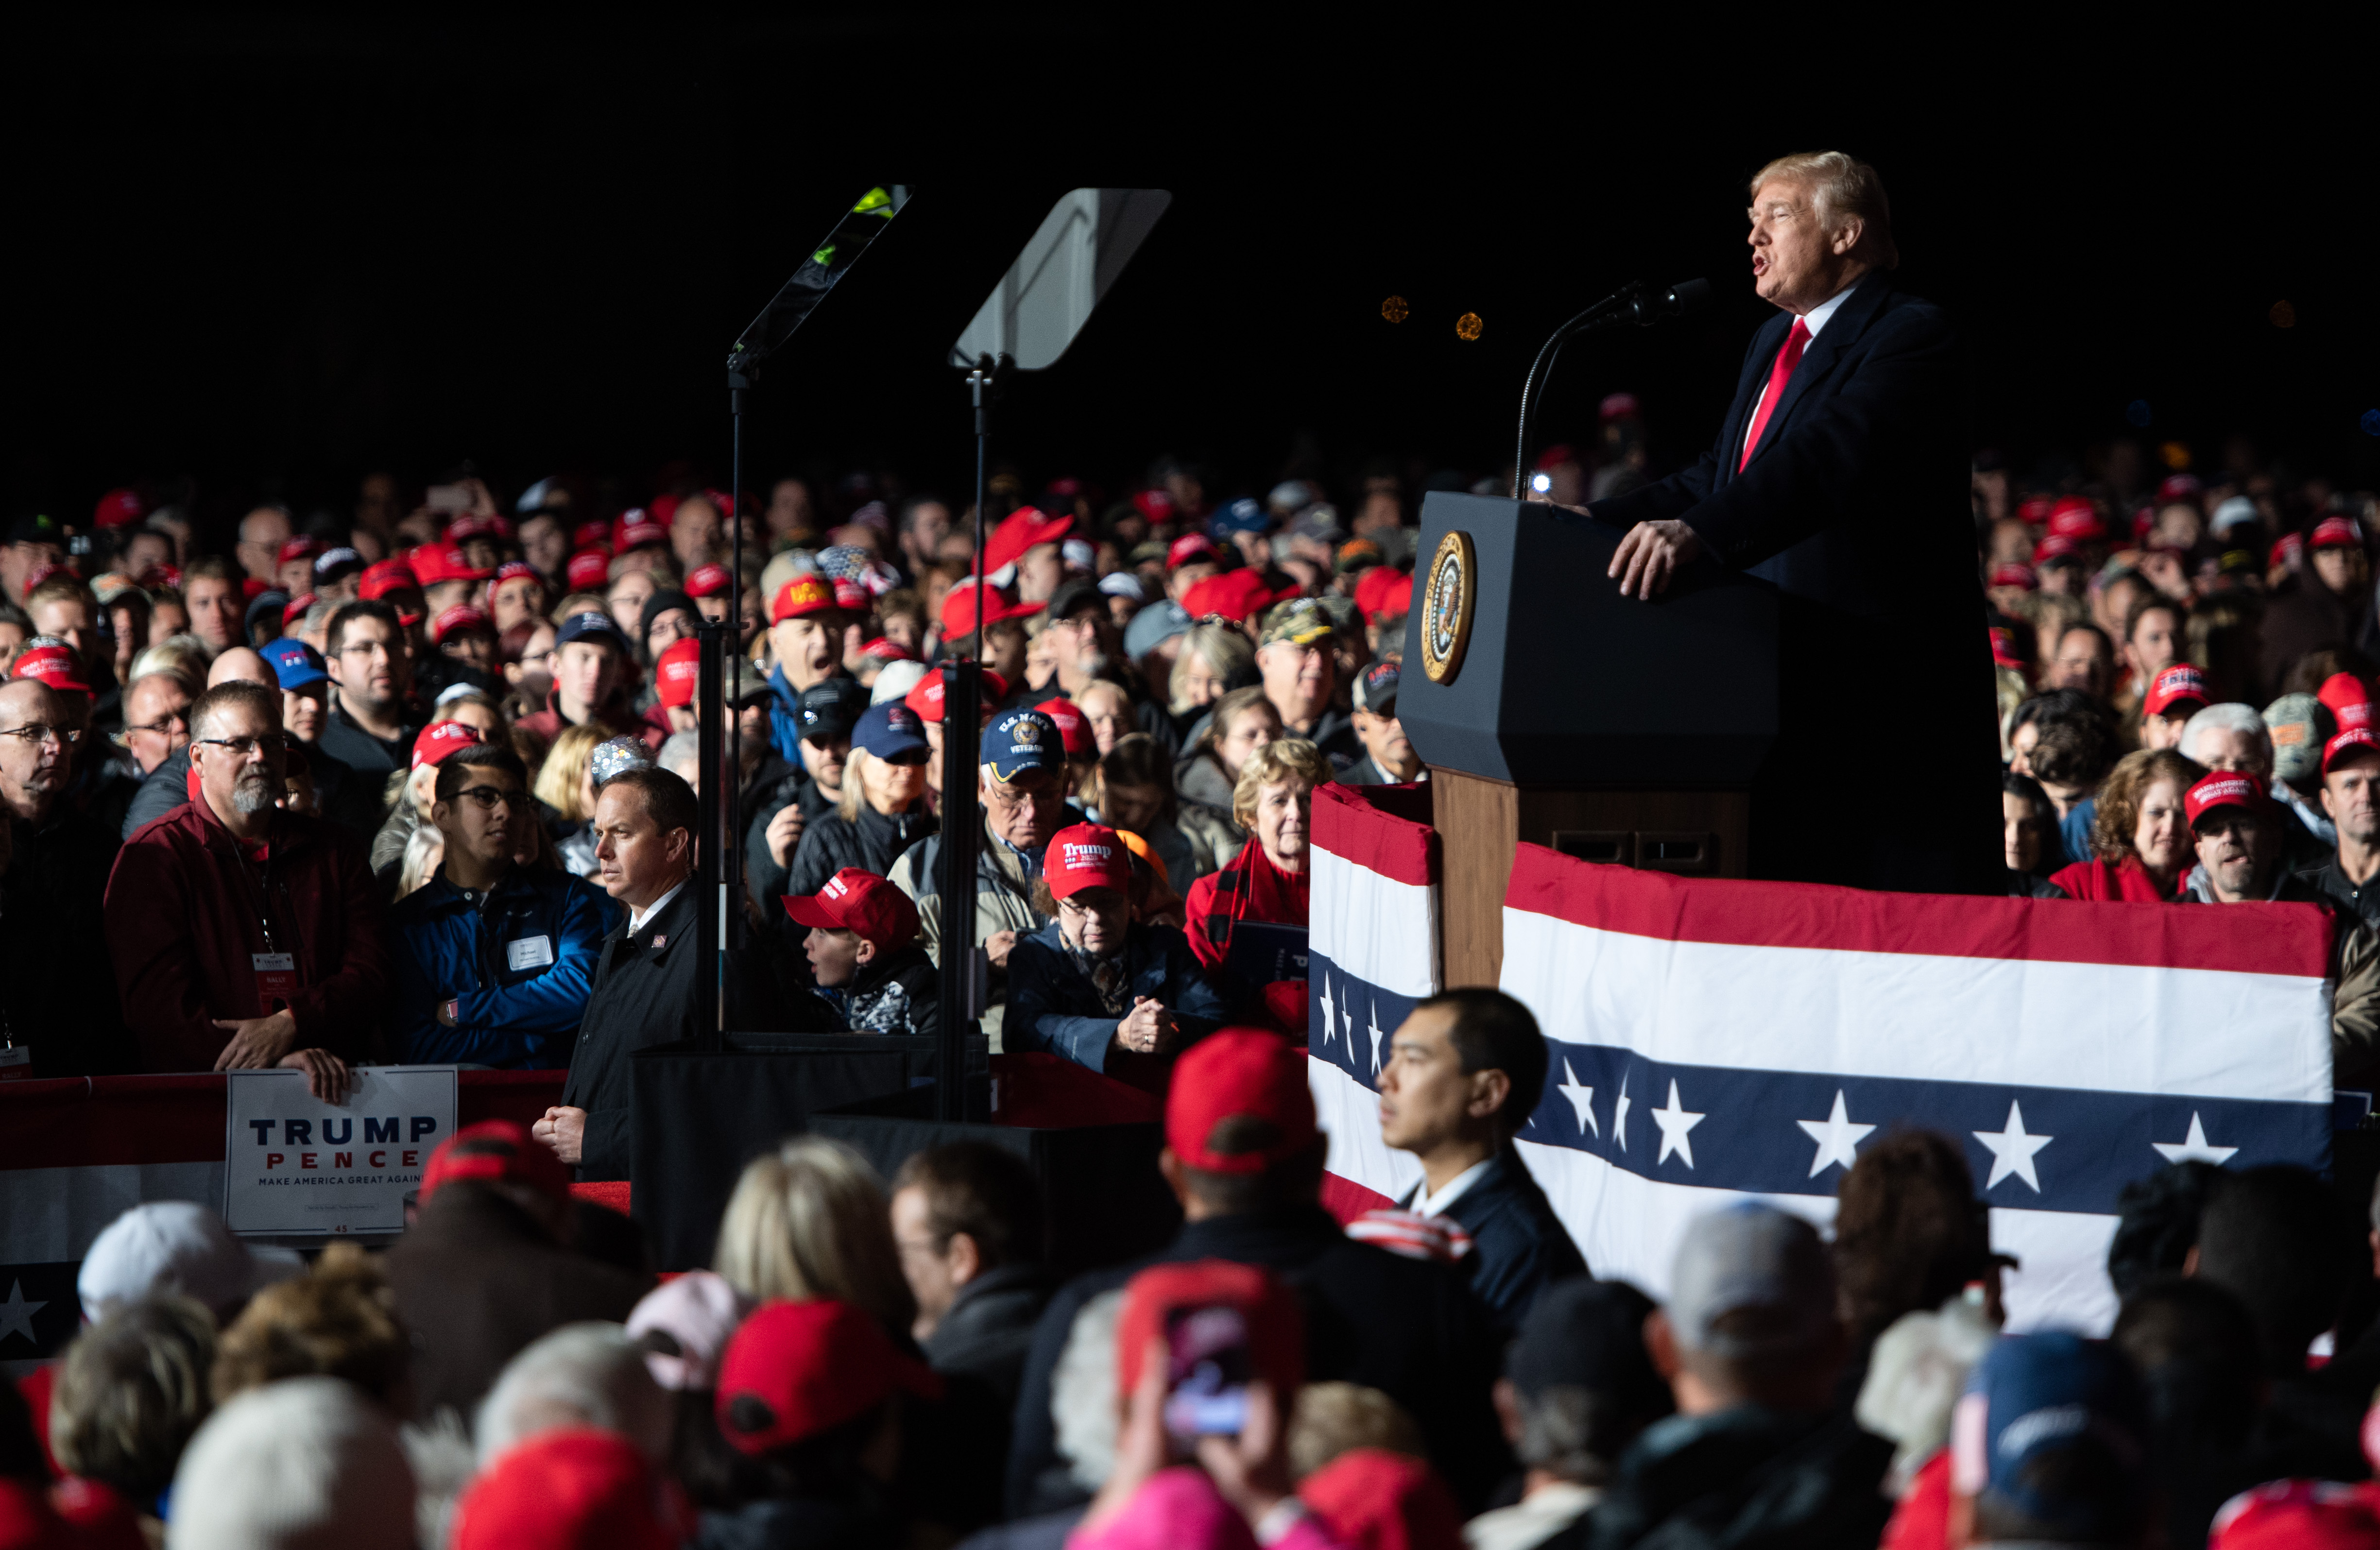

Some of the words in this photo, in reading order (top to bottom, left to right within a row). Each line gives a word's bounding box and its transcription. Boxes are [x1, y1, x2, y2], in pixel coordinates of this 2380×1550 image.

[998, 716, 1018, 732] U.S.
[1019, 713, 1051, 732] NAVY
[1010, 744, 1044, 754] VETERAN
[2192, 783, 2215, 800] MAKE
[2215, 779, 2251, 789] AMERICA
[2223, 786, 2249, 796] AGAIN
[1063, 843, 1112, 860] Trump
[249, 1117, 437, 1145] TRUMP
[267, 1150, 418, 1169] PENCE
[294, 1176, 343, 1185] AMERICA
[348, 1175, 384, 1184] GREAT
[334, 1225, 347, 1233] 45
